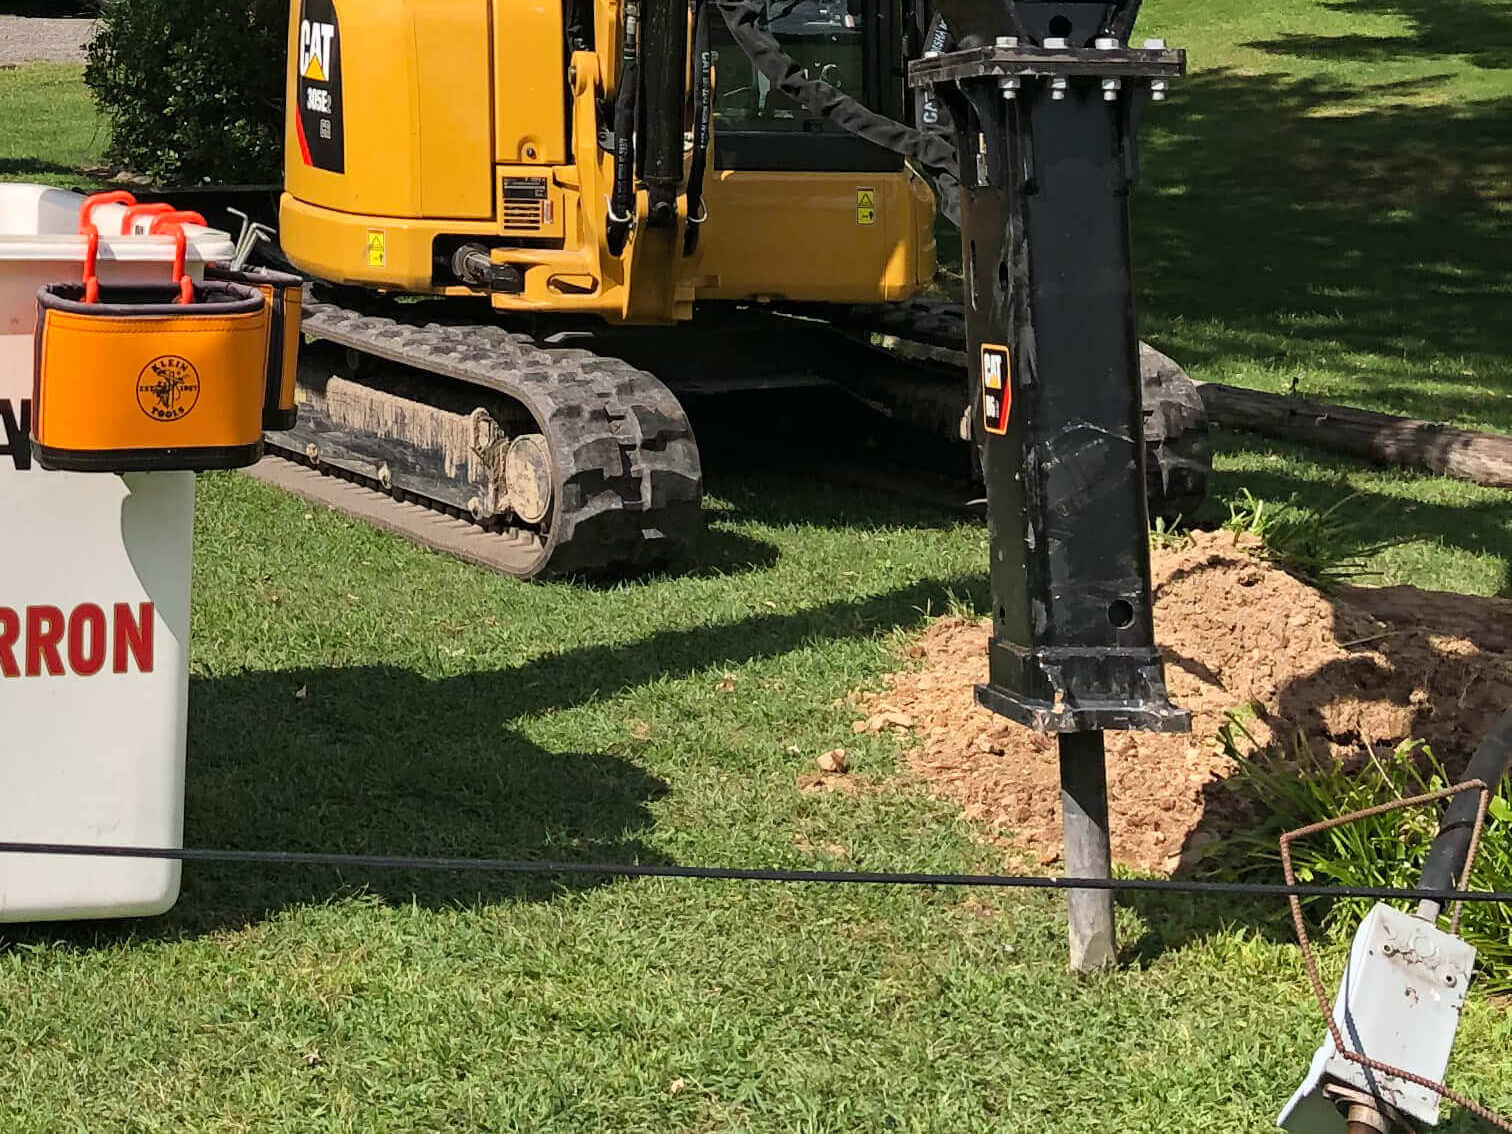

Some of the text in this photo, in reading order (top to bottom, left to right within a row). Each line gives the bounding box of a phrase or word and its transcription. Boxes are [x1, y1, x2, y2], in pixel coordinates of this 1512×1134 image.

[299, 19, 334, 82] CAT
[150, 358, 189, 373] KLEIN
[151, 406, 185, 419] TOOLS
